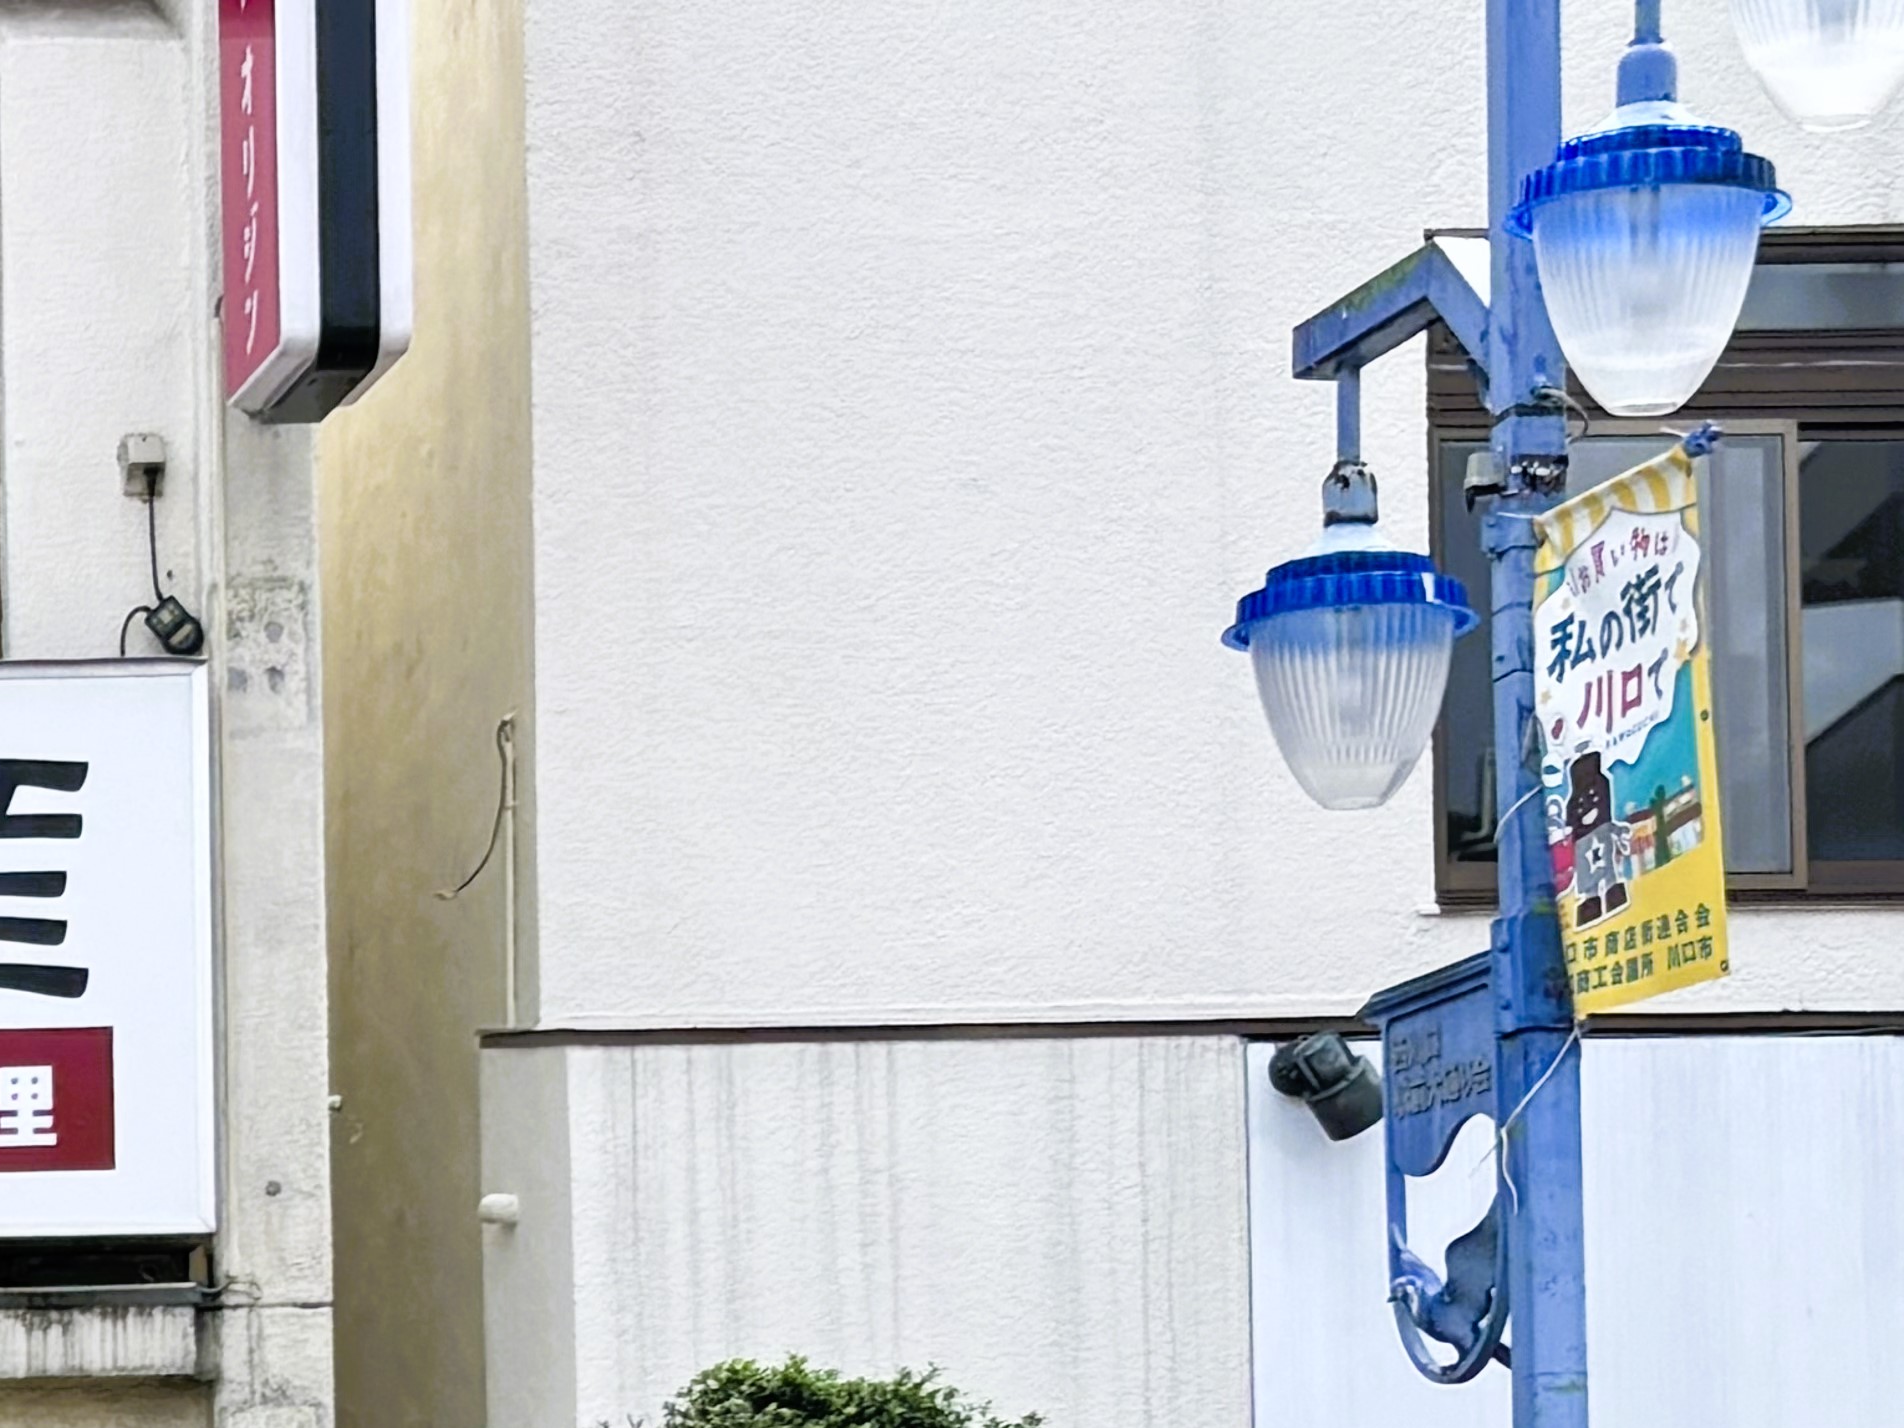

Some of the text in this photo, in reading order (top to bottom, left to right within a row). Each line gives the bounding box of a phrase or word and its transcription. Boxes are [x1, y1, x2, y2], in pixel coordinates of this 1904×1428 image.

[1566, 902, 1711, 964] 口市商店街連合会
[1569, 951, 1654, 994] 商工会議所
